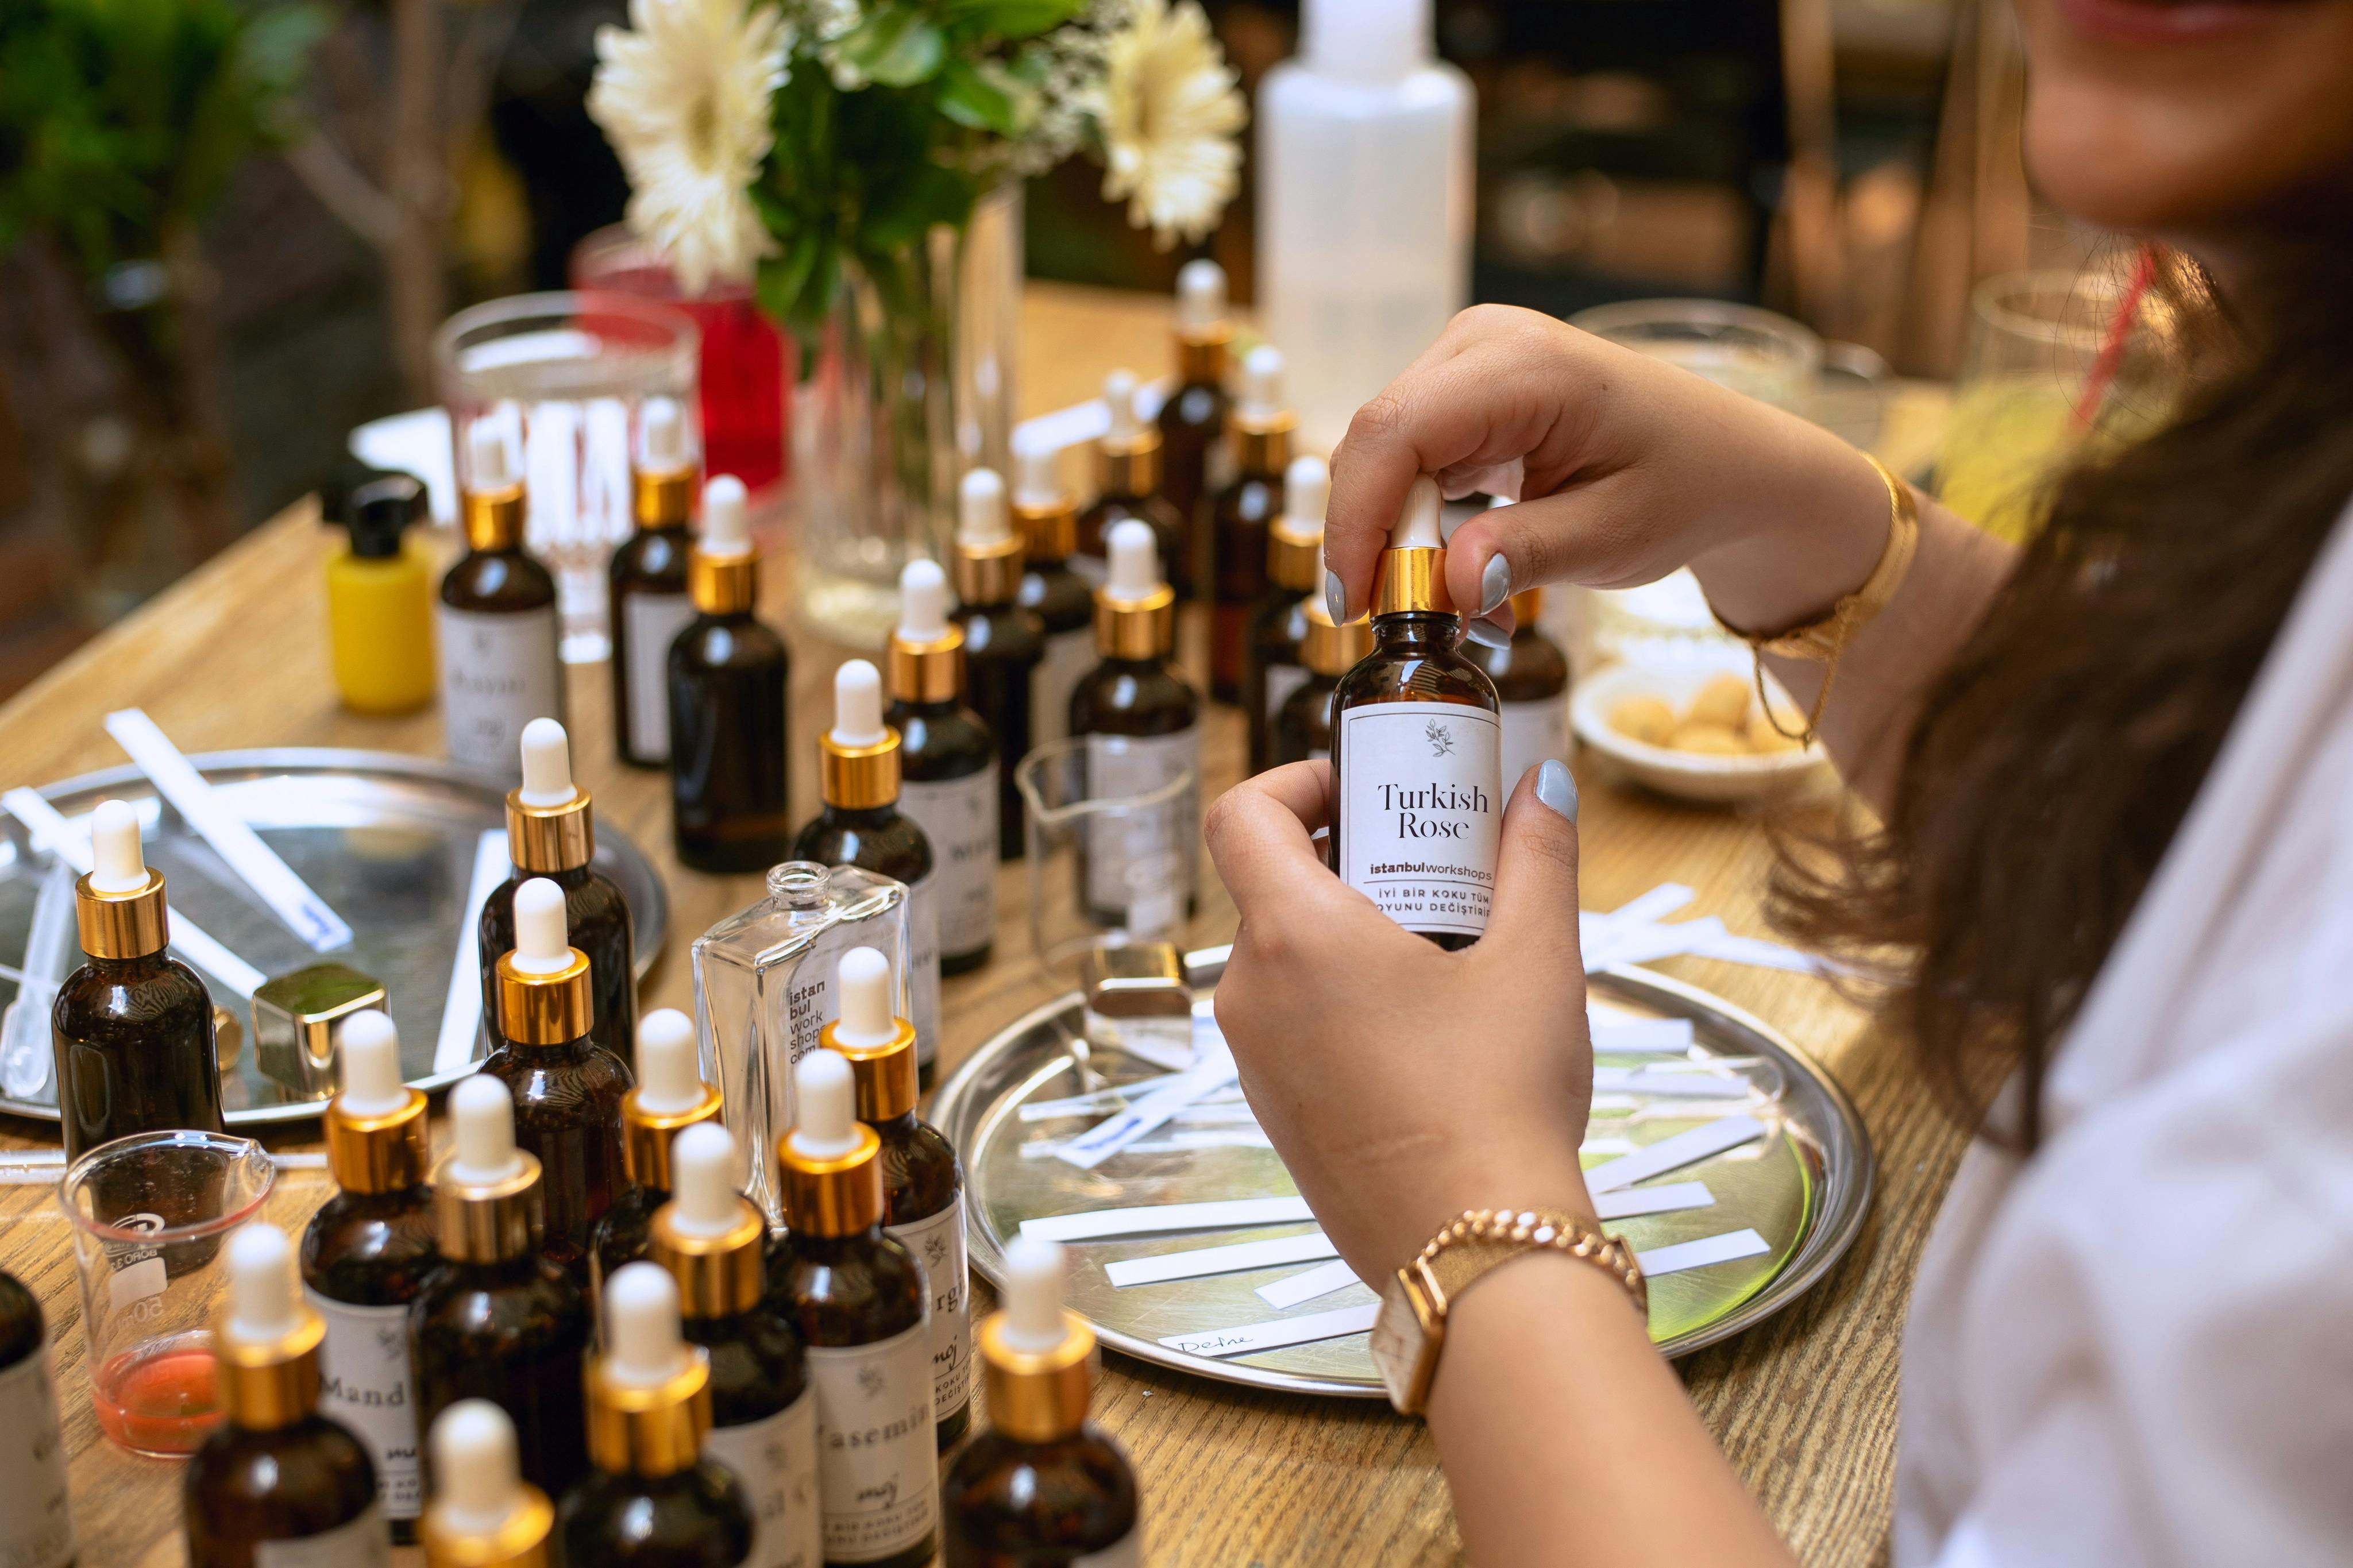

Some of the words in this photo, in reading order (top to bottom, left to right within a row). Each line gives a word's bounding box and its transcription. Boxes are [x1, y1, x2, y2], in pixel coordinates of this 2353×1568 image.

[1378, 783, 1490, 813] Turkish
[1398, 812, 1469, 840] Rose
[1370, 862, 1492, 880] istanbulworkshops
[1379, 887, 1396, 898] İYİ
[1402, 887, 1426, 898] BİR
[1432, 890, 1467, 900] KOKU
[1471, 892, 1489, 904] TÜM
[790, 980, 825, 1006] istan
[790, 999, 811, 1020] bul
[790, 1010, 823, 1034] work
[935, 1373, 960, 1393] KOKU
